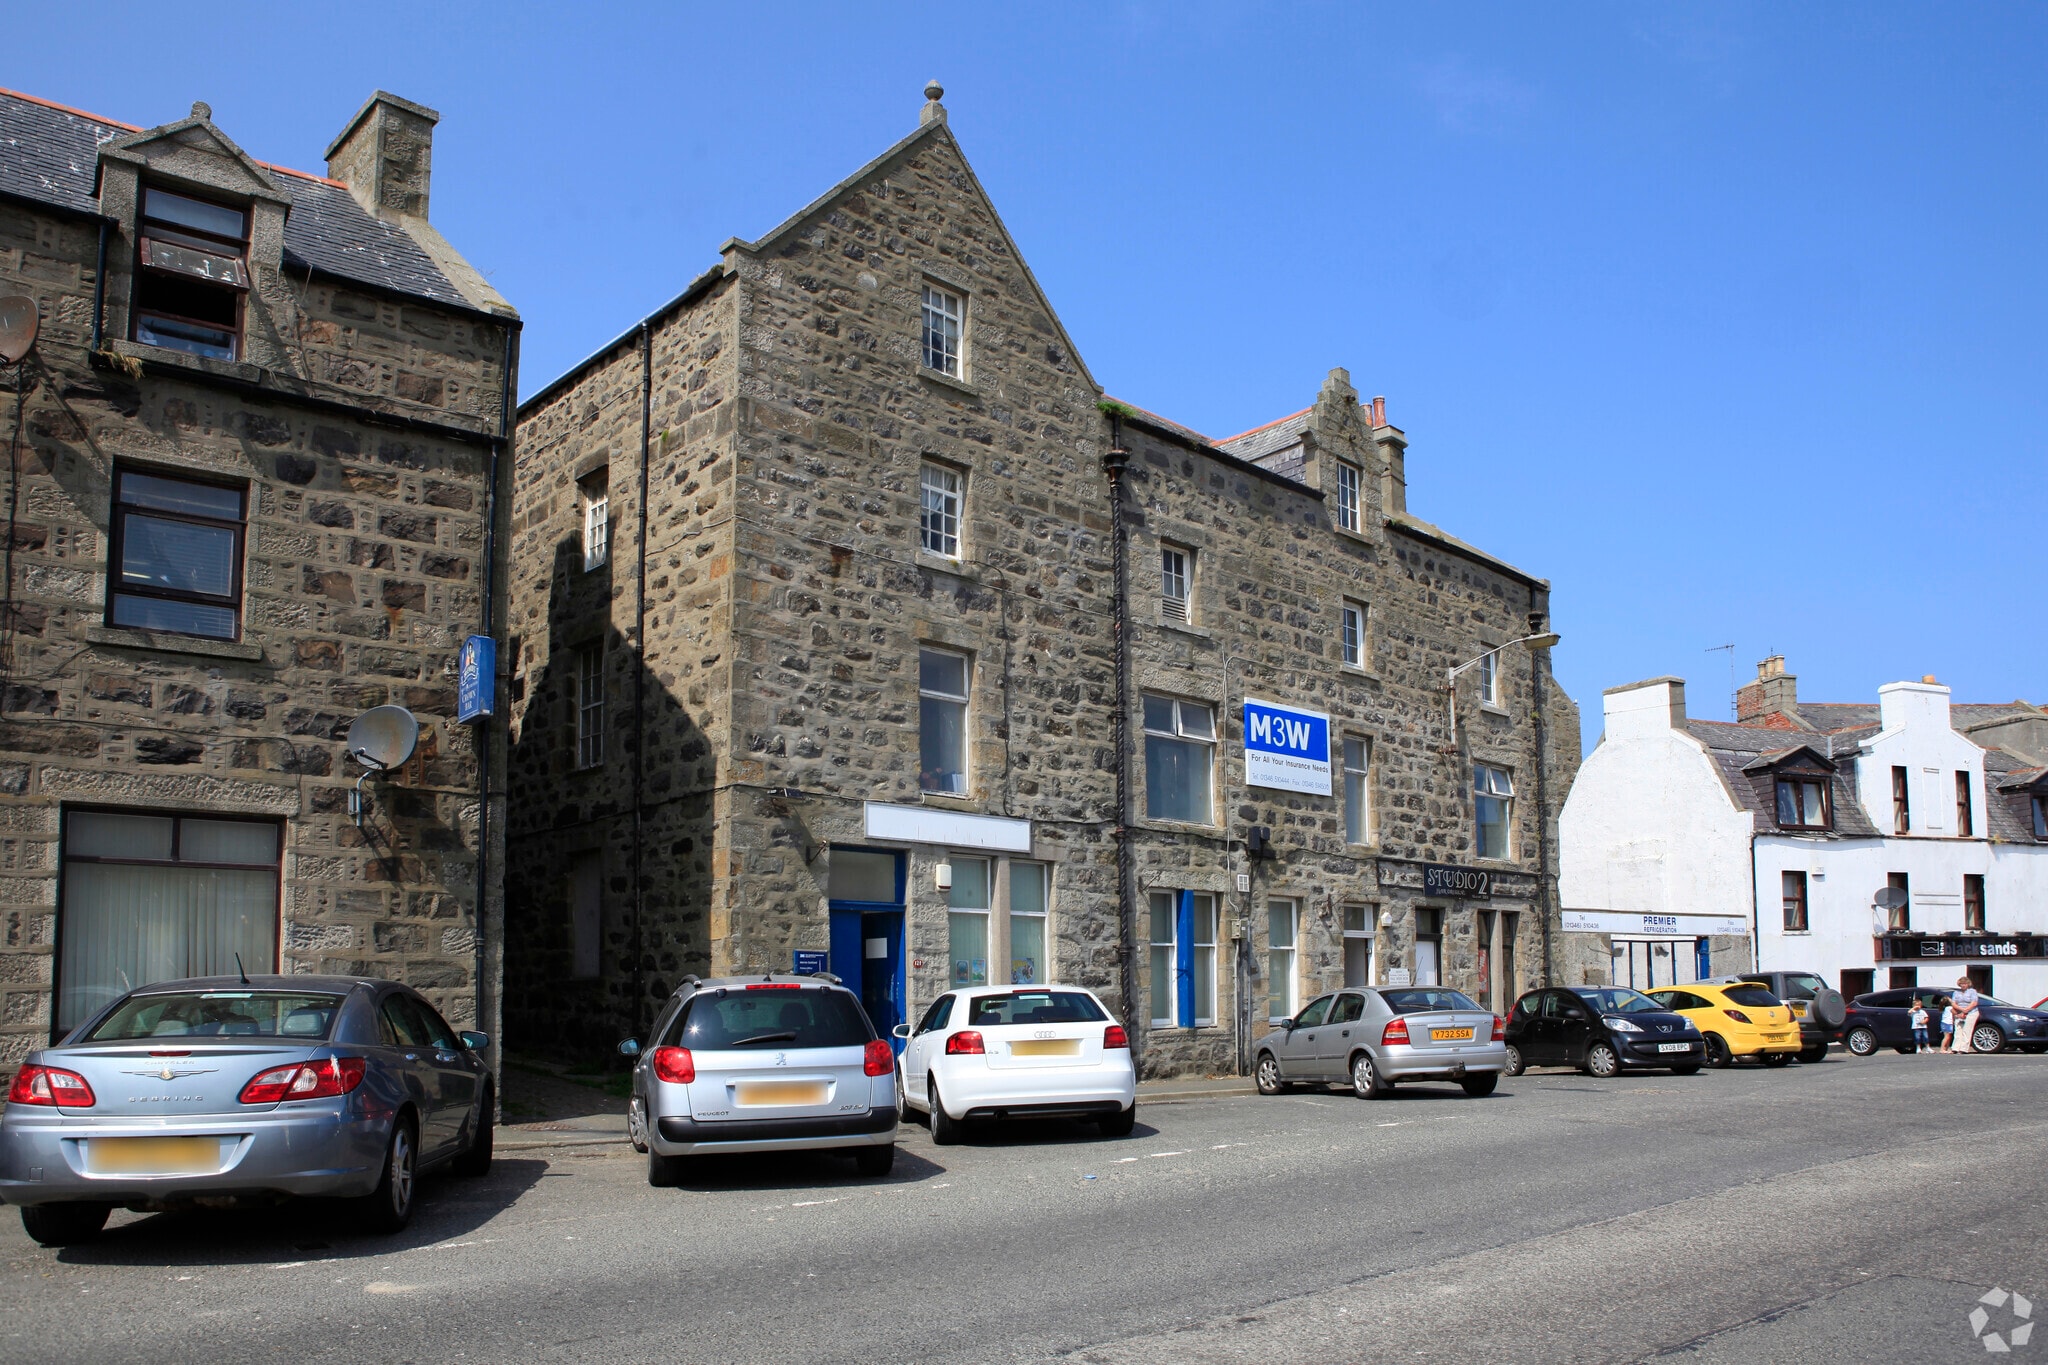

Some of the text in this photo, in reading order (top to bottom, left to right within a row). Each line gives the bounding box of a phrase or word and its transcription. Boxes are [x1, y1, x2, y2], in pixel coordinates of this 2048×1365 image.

[1250, 712, 1311, 751] M3W
[1272, 757, 1284, 765] Your
[1285, 759, 1311, 770] Insurance
[1312, 764, 1329, 773] Needs
[1428, 868, 1488, 895] STUDIO 2
[1643, 916, 1676, 925] PREMIER
[1946, 941, 1979, 956] black
[1980, 941, 2017, 956] sands
[1435, 1030, 1455, 1038] Y732
